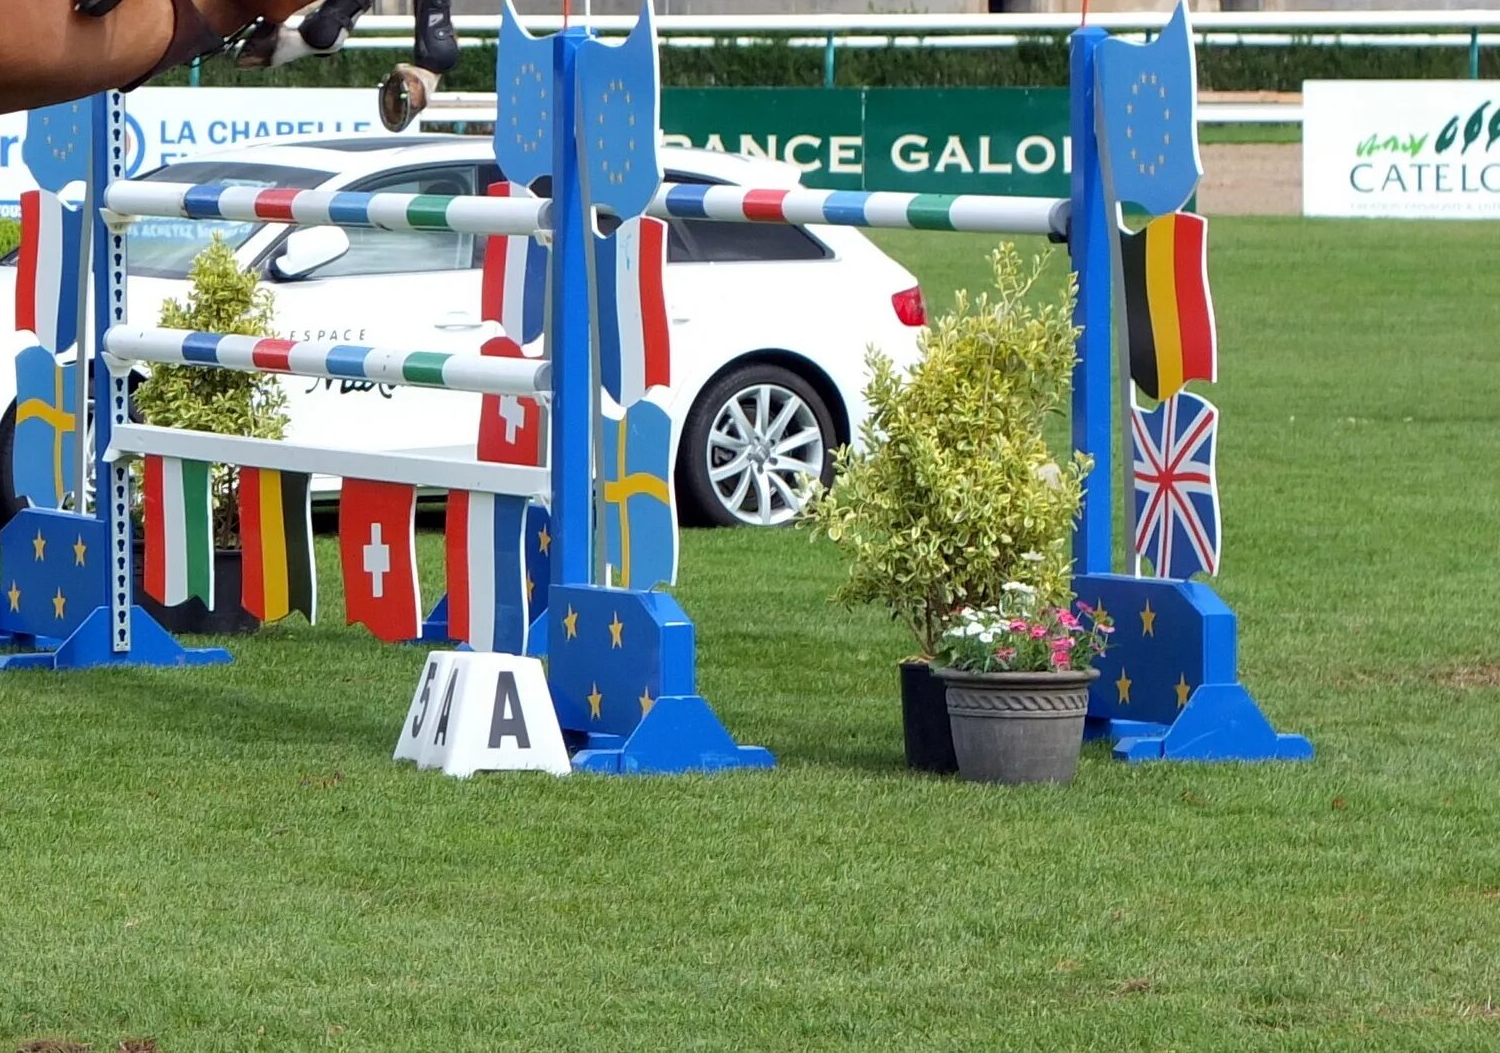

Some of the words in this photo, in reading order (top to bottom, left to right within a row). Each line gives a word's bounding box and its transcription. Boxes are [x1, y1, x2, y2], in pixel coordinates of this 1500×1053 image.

[160, 121, 197, 144] LA
[890, 134, 1071, 175] GALO
[487, 670, 532, 749] A
